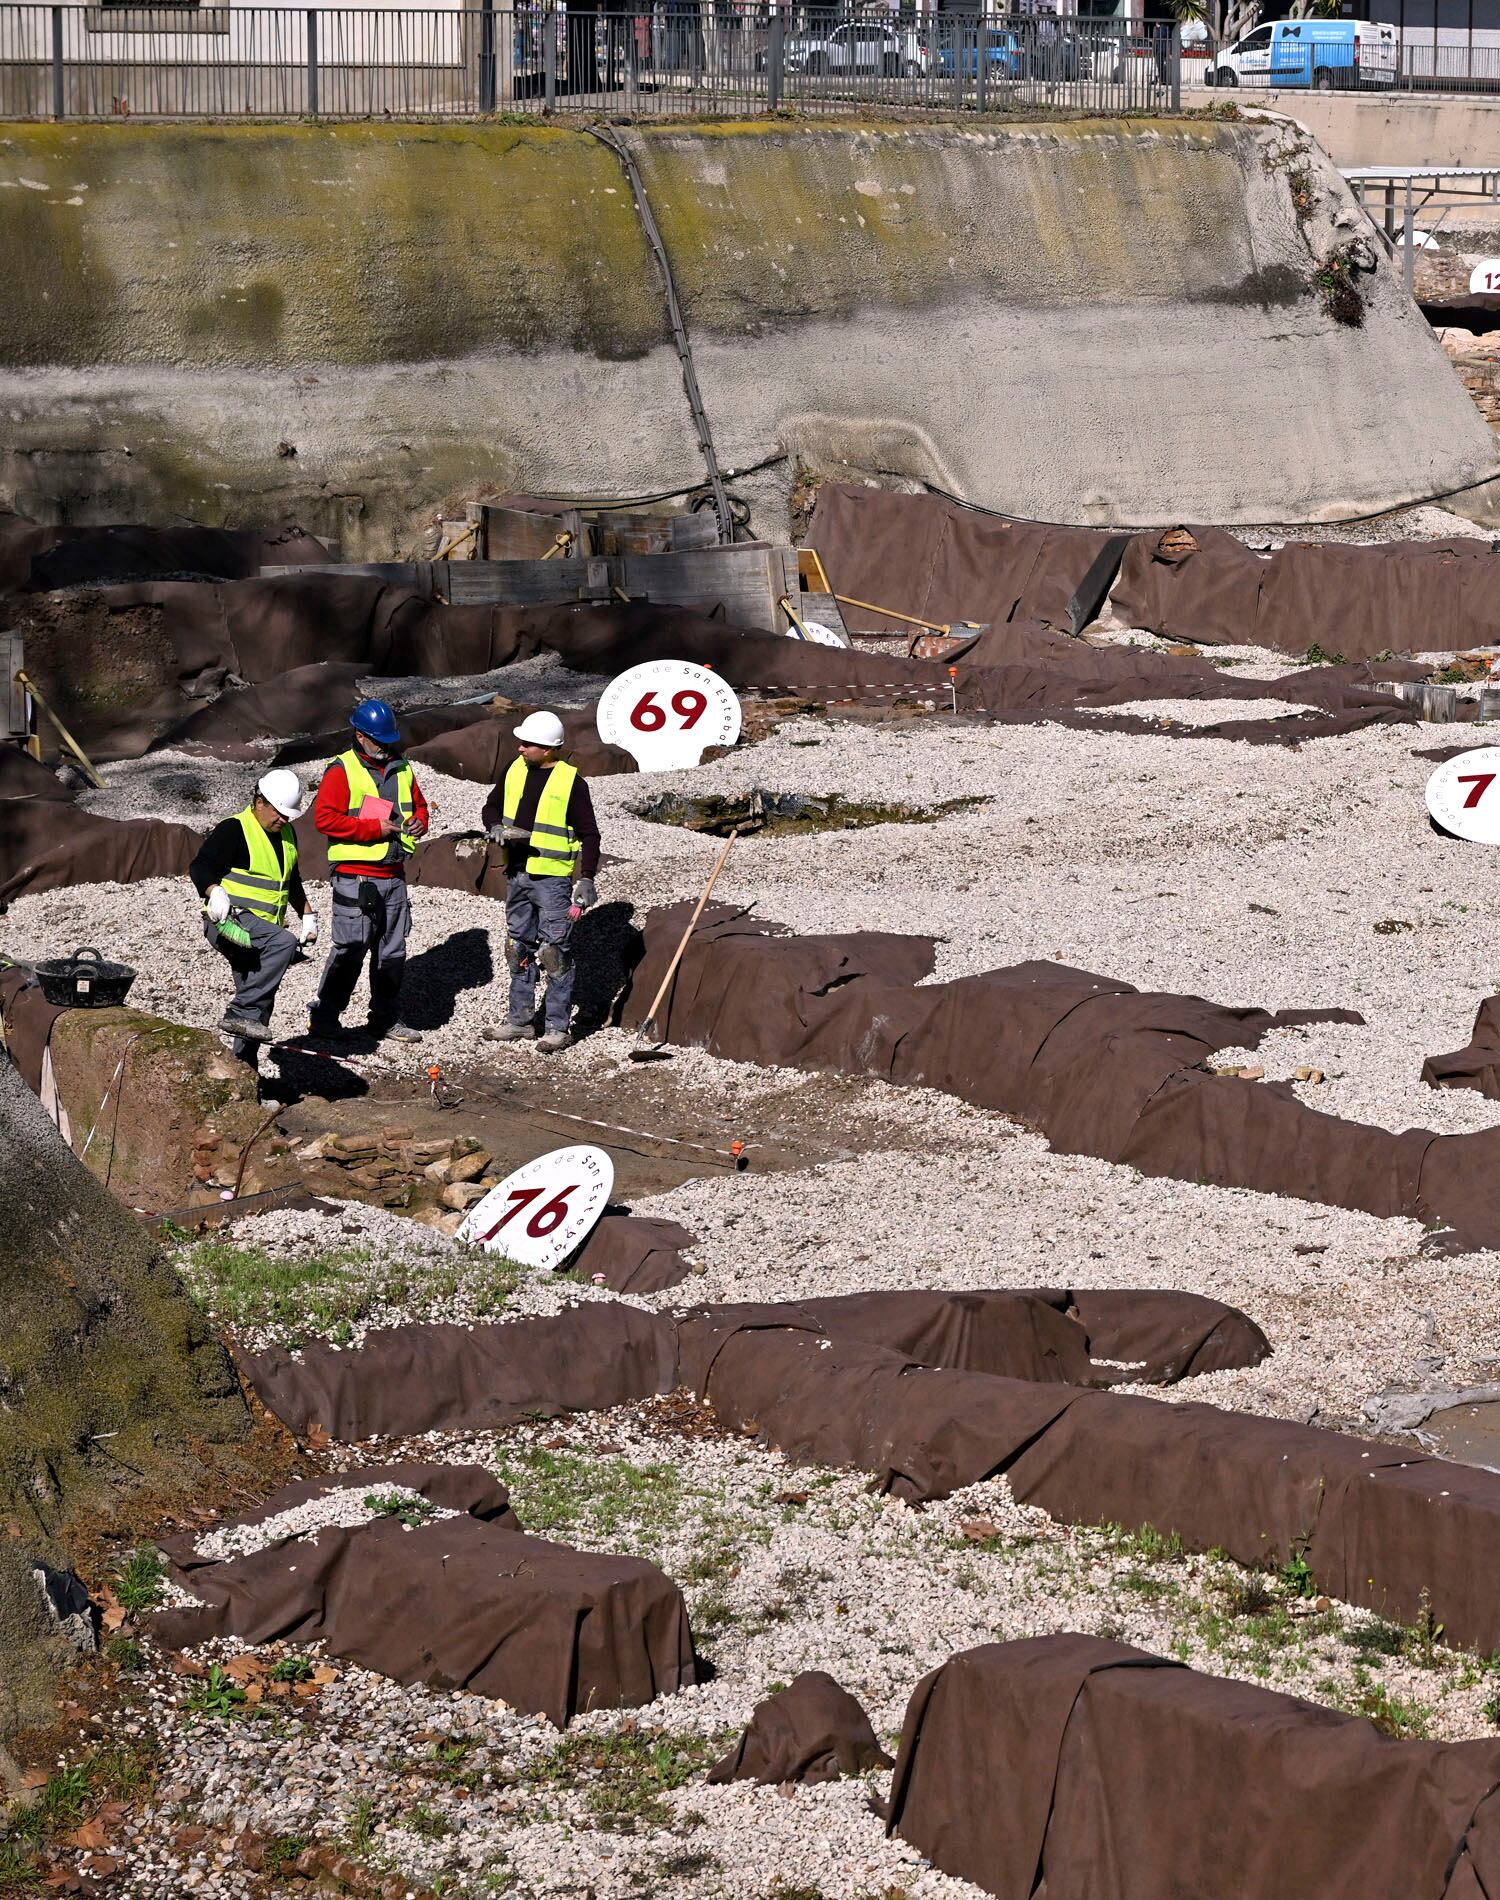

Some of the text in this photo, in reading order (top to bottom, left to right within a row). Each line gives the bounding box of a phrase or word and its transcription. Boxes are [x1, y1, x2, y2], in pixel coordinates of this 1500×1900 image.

[683, 667, 711, 685] San
[630, 690, 707, 732] 69
[581, 1155, 601, 1177] San
[484, 1185, 580, 1241] 76
[541, 1182, 603, 1263] Esteban
